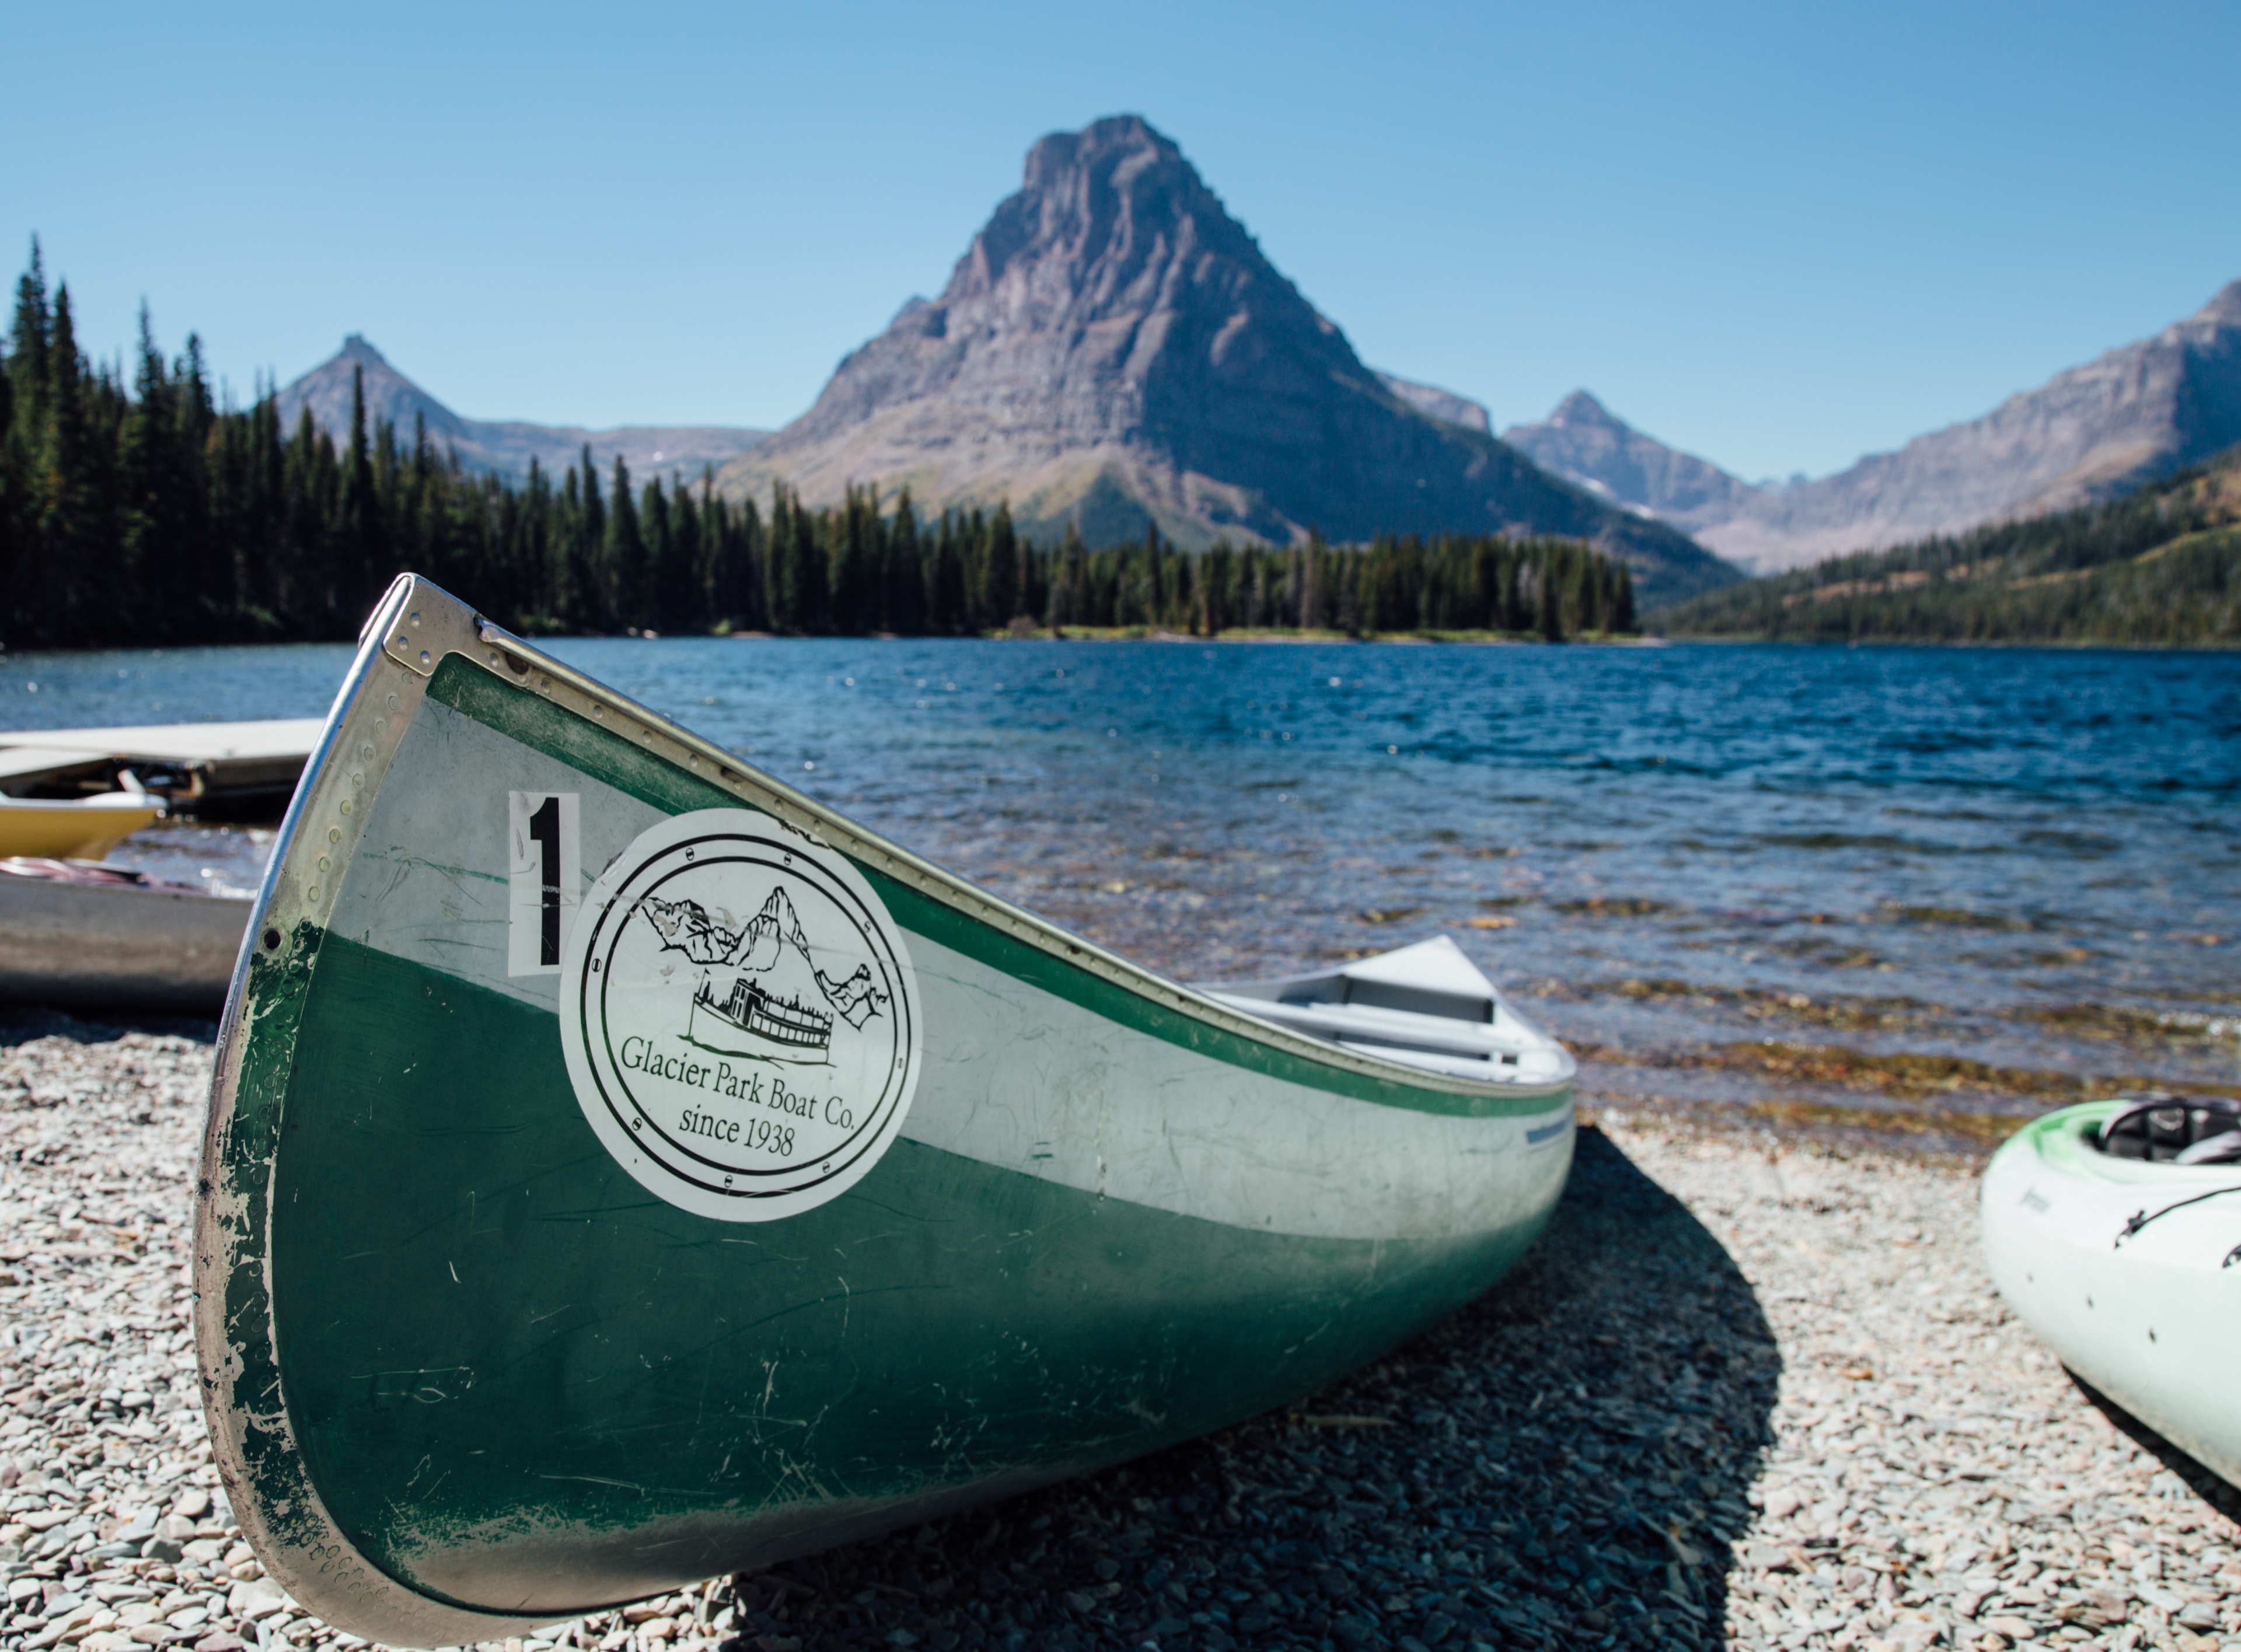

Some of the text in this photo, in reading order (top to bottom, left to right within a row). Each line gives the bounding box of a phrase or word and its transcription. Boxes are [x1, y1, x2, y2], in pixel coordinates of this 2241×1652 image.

[530, 797, 559, 965] 1
[621, 1036, 854, 1130] Glacier Park Boat Co.
[679, 1104, 795, 1157] since 1938
